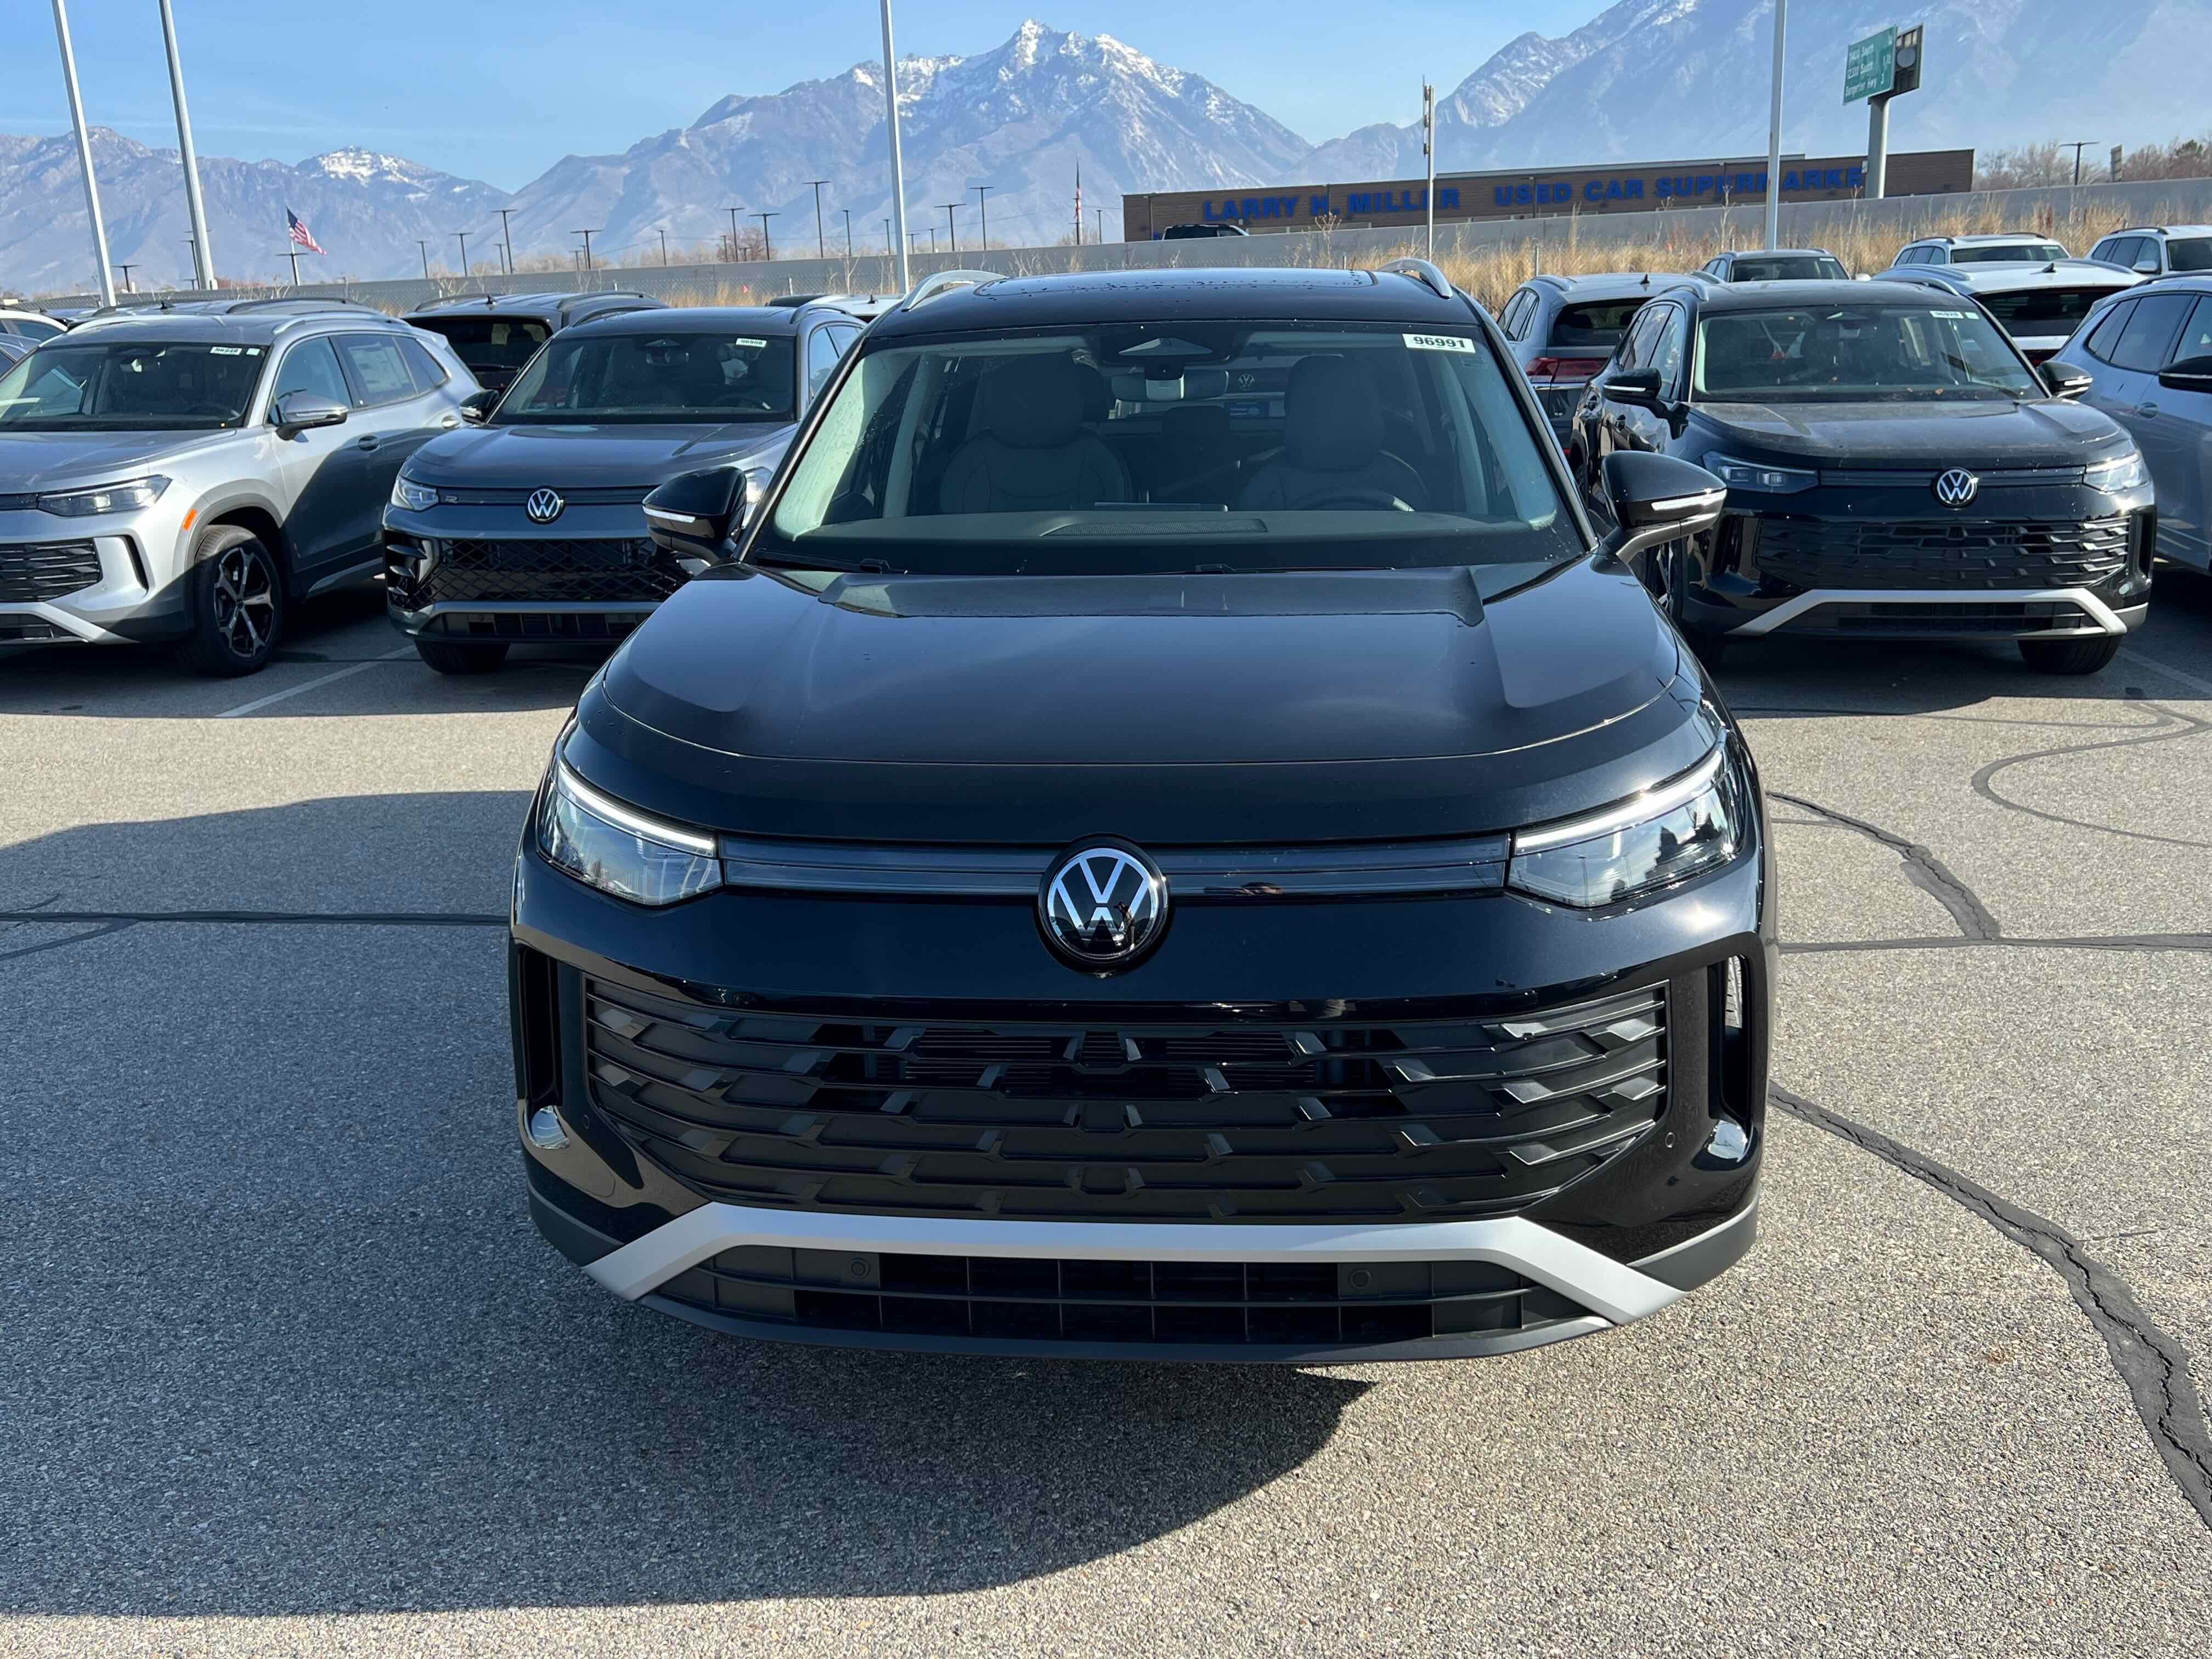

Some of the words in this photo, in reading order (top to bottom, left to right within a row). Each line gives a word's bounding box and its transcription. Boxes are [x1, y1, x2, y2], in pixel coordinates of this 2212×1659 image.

[1203, 196, 1299, 221] LARRY
[1494, 182, 1572, 206] USED
[1584, 178, 1644, 201] CAR
[1413, 336, 1465, 348] 96991
